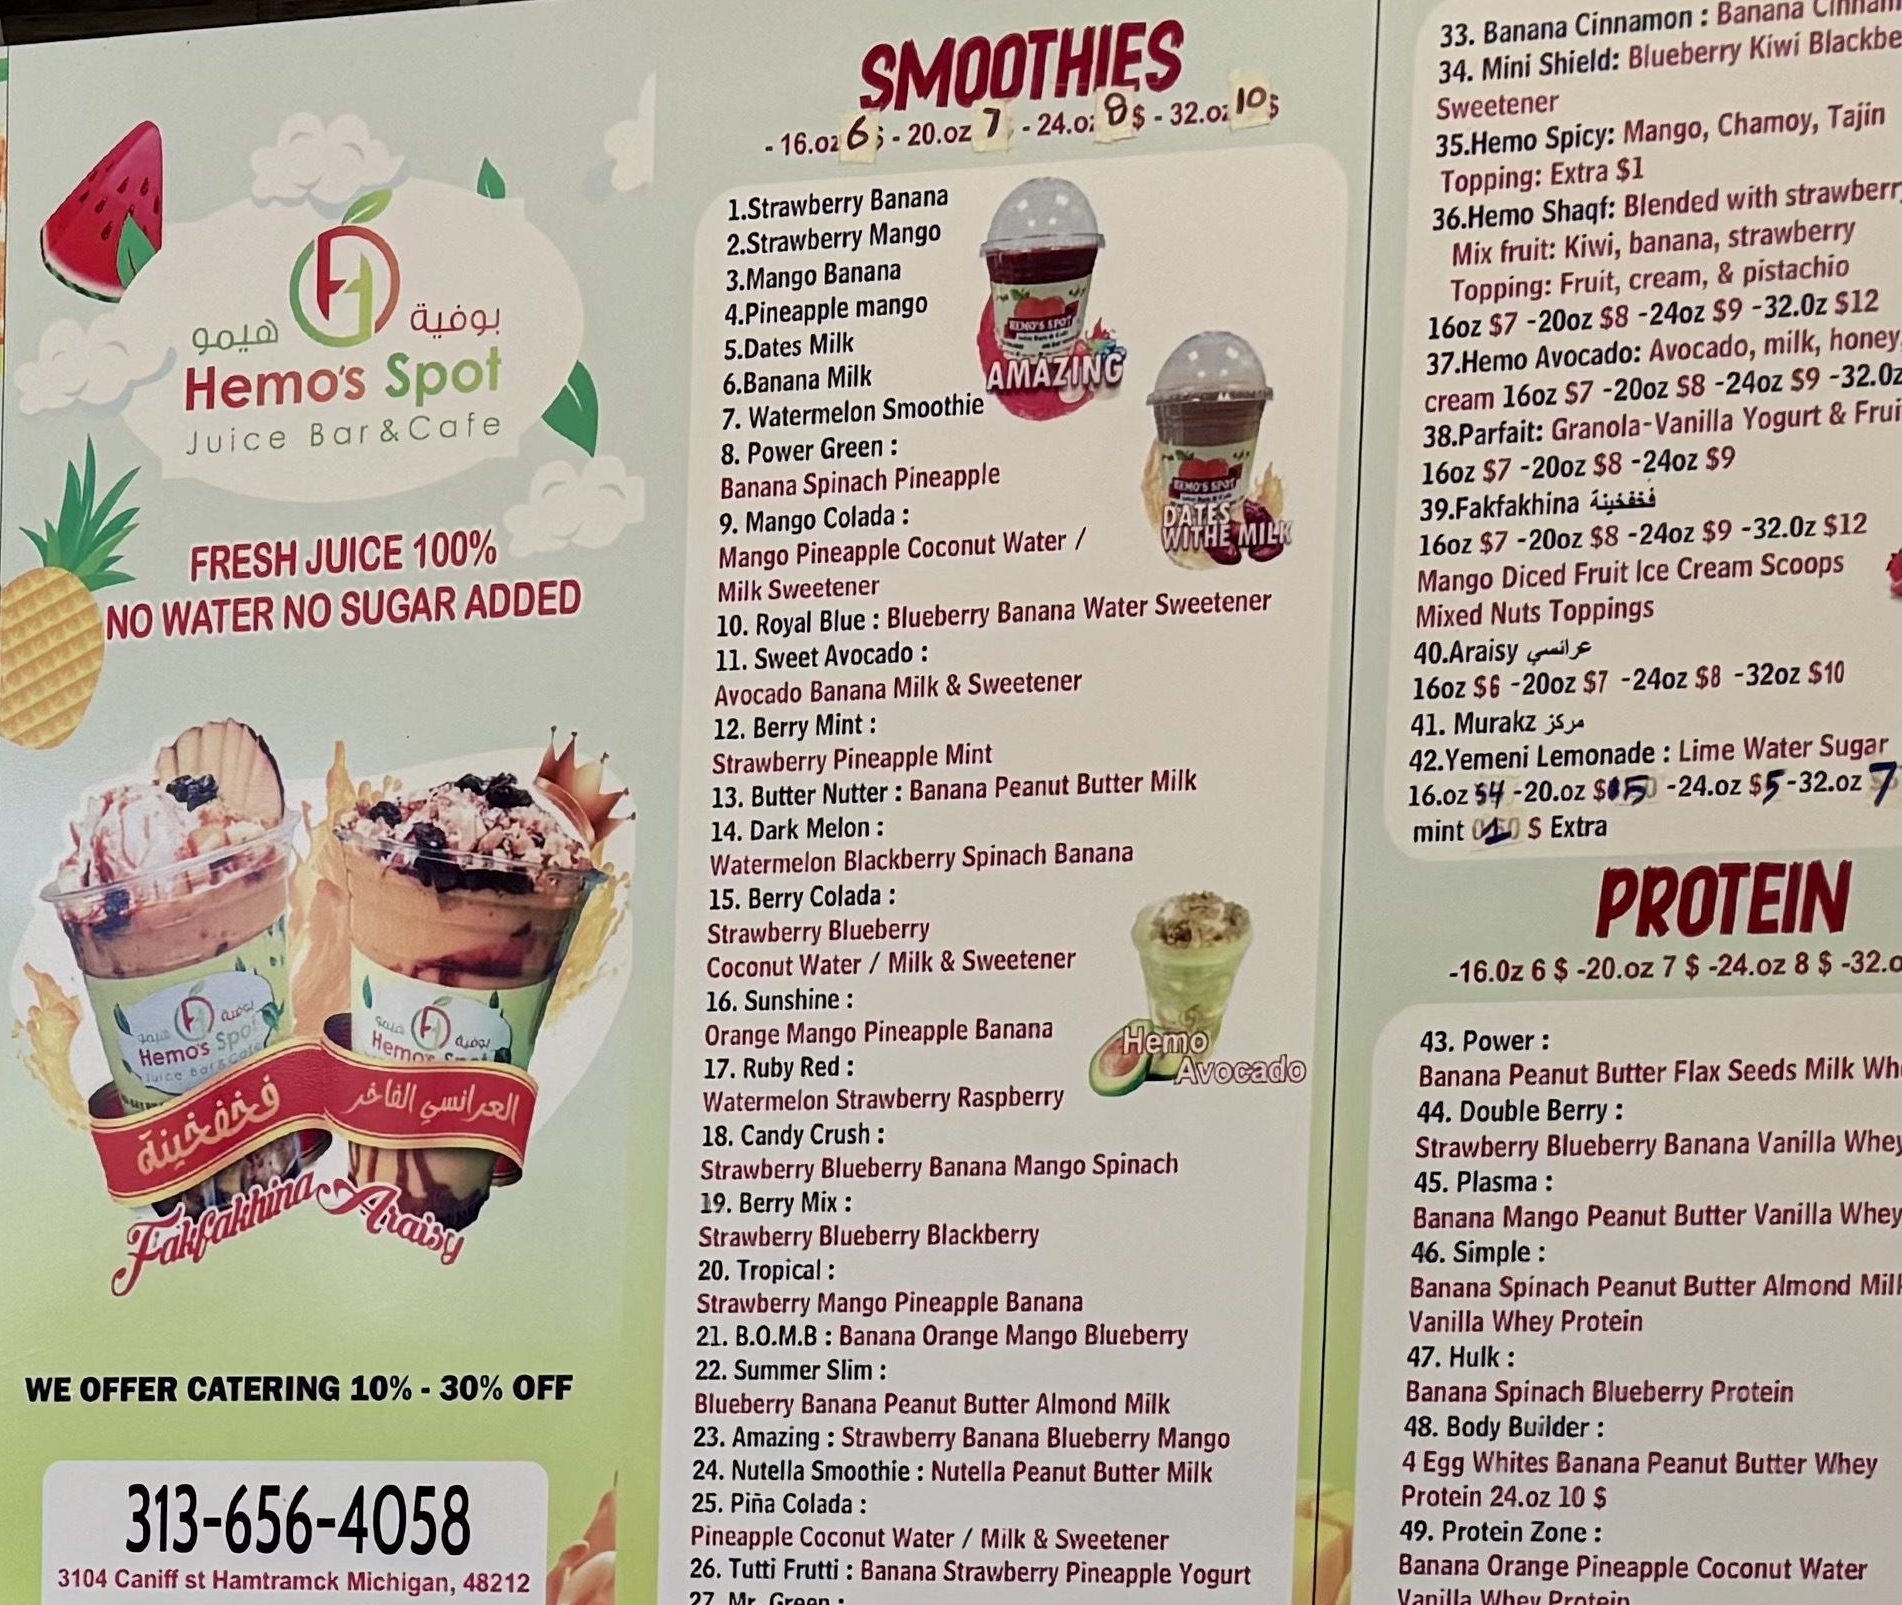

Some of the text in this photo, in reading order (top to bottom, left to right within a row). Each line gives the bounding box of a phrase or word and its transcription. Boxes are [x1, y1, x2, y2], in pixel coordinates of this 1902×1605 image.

[860, 20, 1185, 112] SMOOTHIES
[728, 186, 949, 223] 1.Strawberry Banana
[727, 222, 942, 258] 2.Strawberry Mango
[191, 303, 502, 355] بوفية هيمو
[185, 345, 502, 411] Hemo's Spot
[986, 354, 1125, 393] AMAZING
[185, 425, 287, 455] Juice
[1162, 502, 1231, 526] DATES
[1160, 521, 1293, 550] WITHE MILK
[190, 529, 497, 581] FRESH JUICE 100%
[1418, 551, 1844, 596] Mango Diced Fruit Ice Cream Scoops
[106, 579, 582, 640] NO WATER NO SUGAR ADDED
[1416, 596, 1654, 629] Mixed Nuts Toppings
[712, 744, 993, 776] Strawberry Pineapple Mint
[1596, 859, 1852, 939] PROTEIN
[1123, 1027, 1208, 1056] Hemo
[1172, 1055, 1307, 1085] Avocado
[25, 1374, 573, 1402] WE OFFER CATERING 10% 30% OFF
[125, 1483, 471, 1557] 313-656-4058
[57, 1569, 531, 1597] 3104 Caniff st Hamtramck Michigan, 48212
